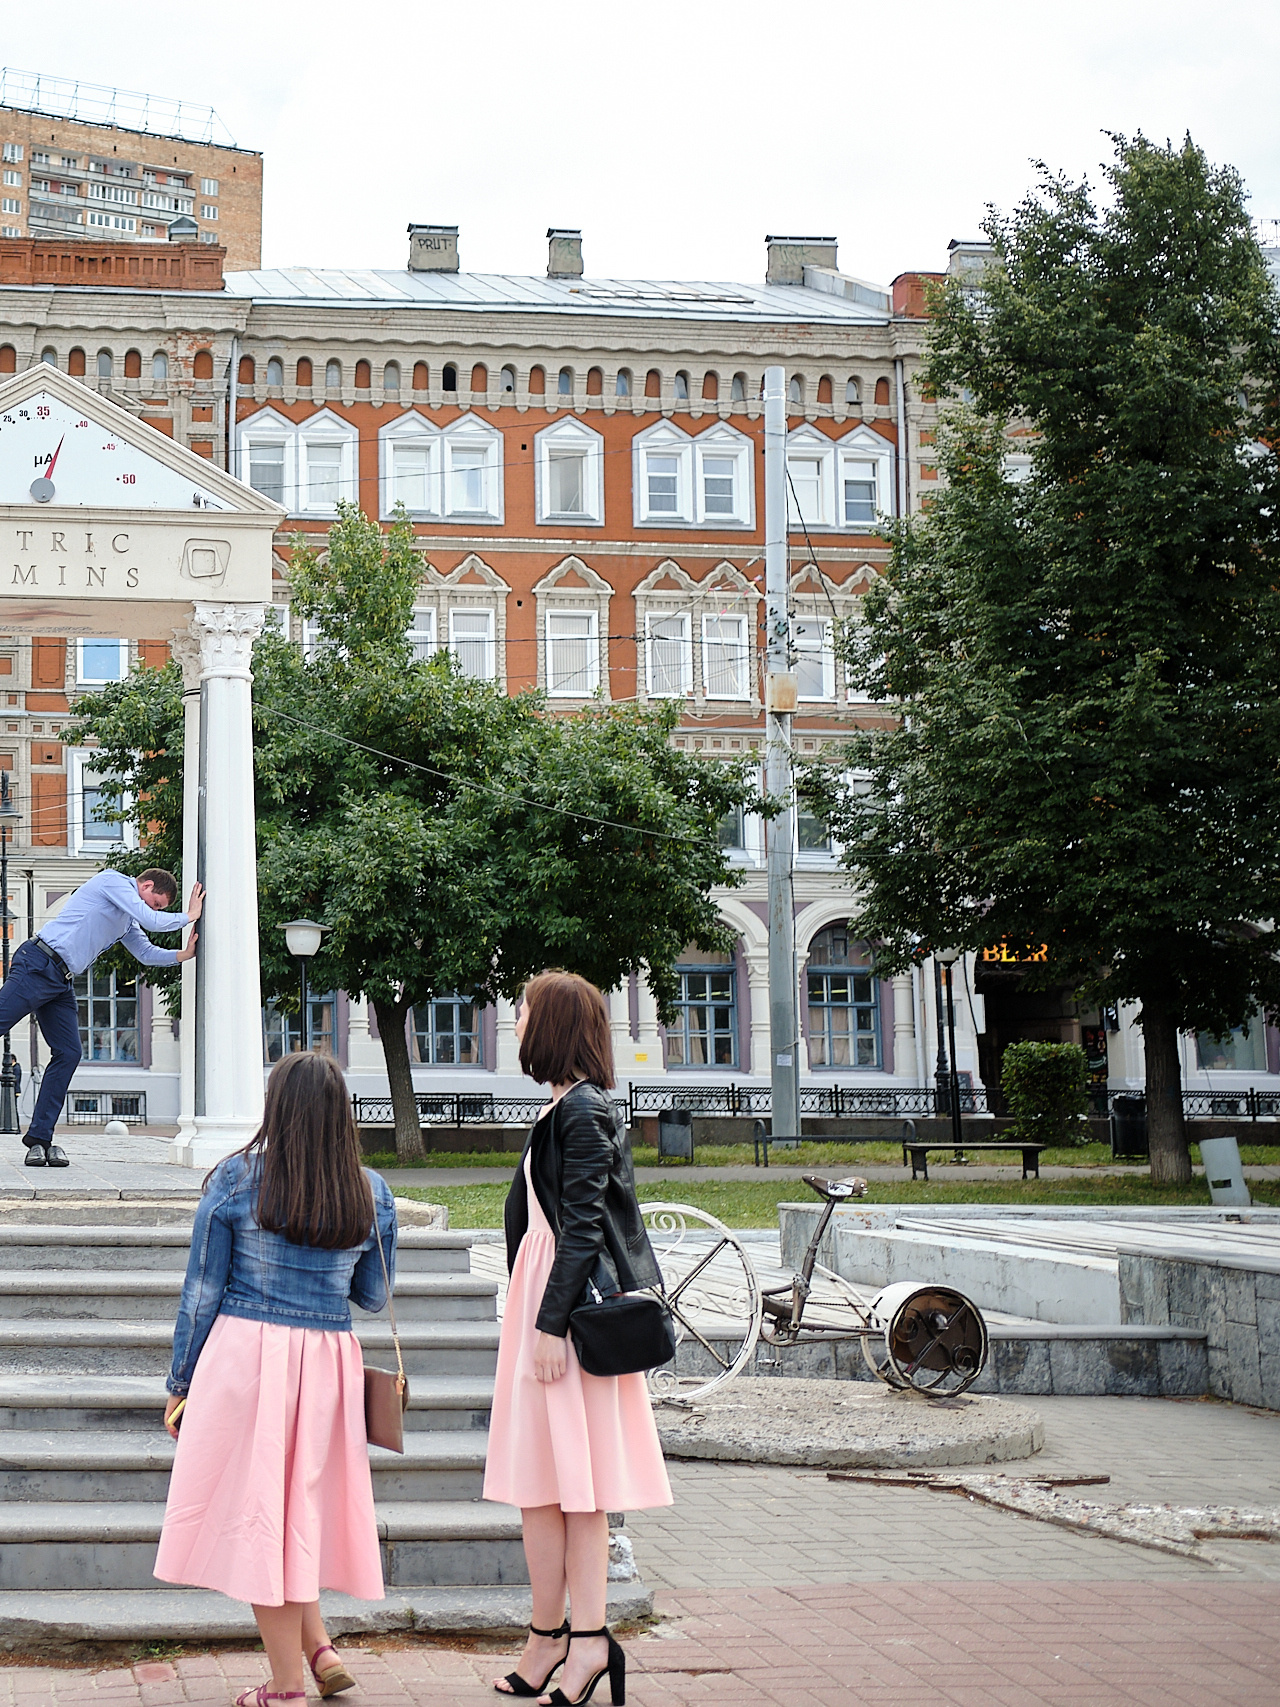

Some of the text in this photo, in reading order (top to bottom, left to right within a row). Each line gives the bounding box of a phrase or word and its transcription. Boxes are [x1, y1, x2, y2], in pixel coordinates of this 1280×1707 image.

[36, 405, 50, 416] 35
[79, 420, 88, 428] 40
[122, 474, 136, 485] 50
